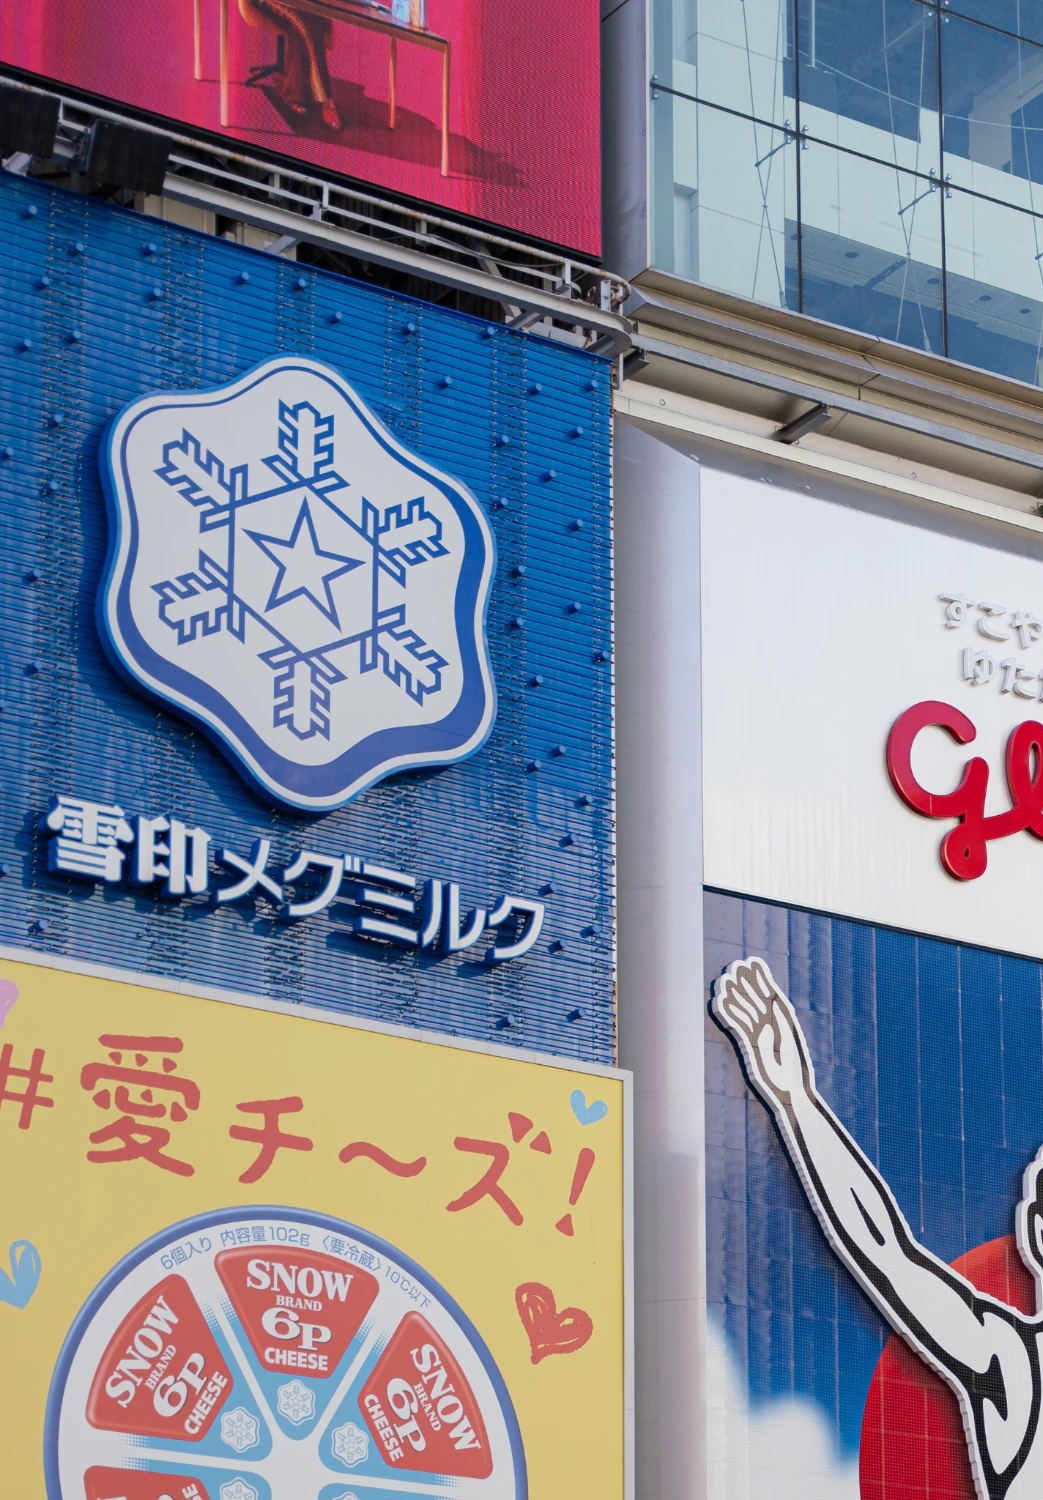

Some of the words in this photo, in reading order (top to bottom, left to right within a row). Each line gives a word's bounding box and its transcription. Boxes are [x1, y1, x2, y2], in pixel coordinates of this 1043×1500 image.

[46, 796, 545, 960] 雪印メグミルク
[160, 1237, 212, 1270] 6個入り
[220, 1226, 311, 1247] 内容量102g
[385, 1266, 432, 1308] 10℃以下
[247, 1259, 353, 1302] SNOW
[276, 1295, 322, 1312] BRAND
[105, 1295, 179, 1409] SNOW
[145, 1344, 177, 1390] BRAND
[264, 1347, 328, 1371] CHEESE
[184, 1371, 228, 1434] CHEESE
[364, 1394, 404, 1462] CHEESE
[410, 1343, 481, 1451] SNOW
[413, 1383, 442, 1431] BRAND
